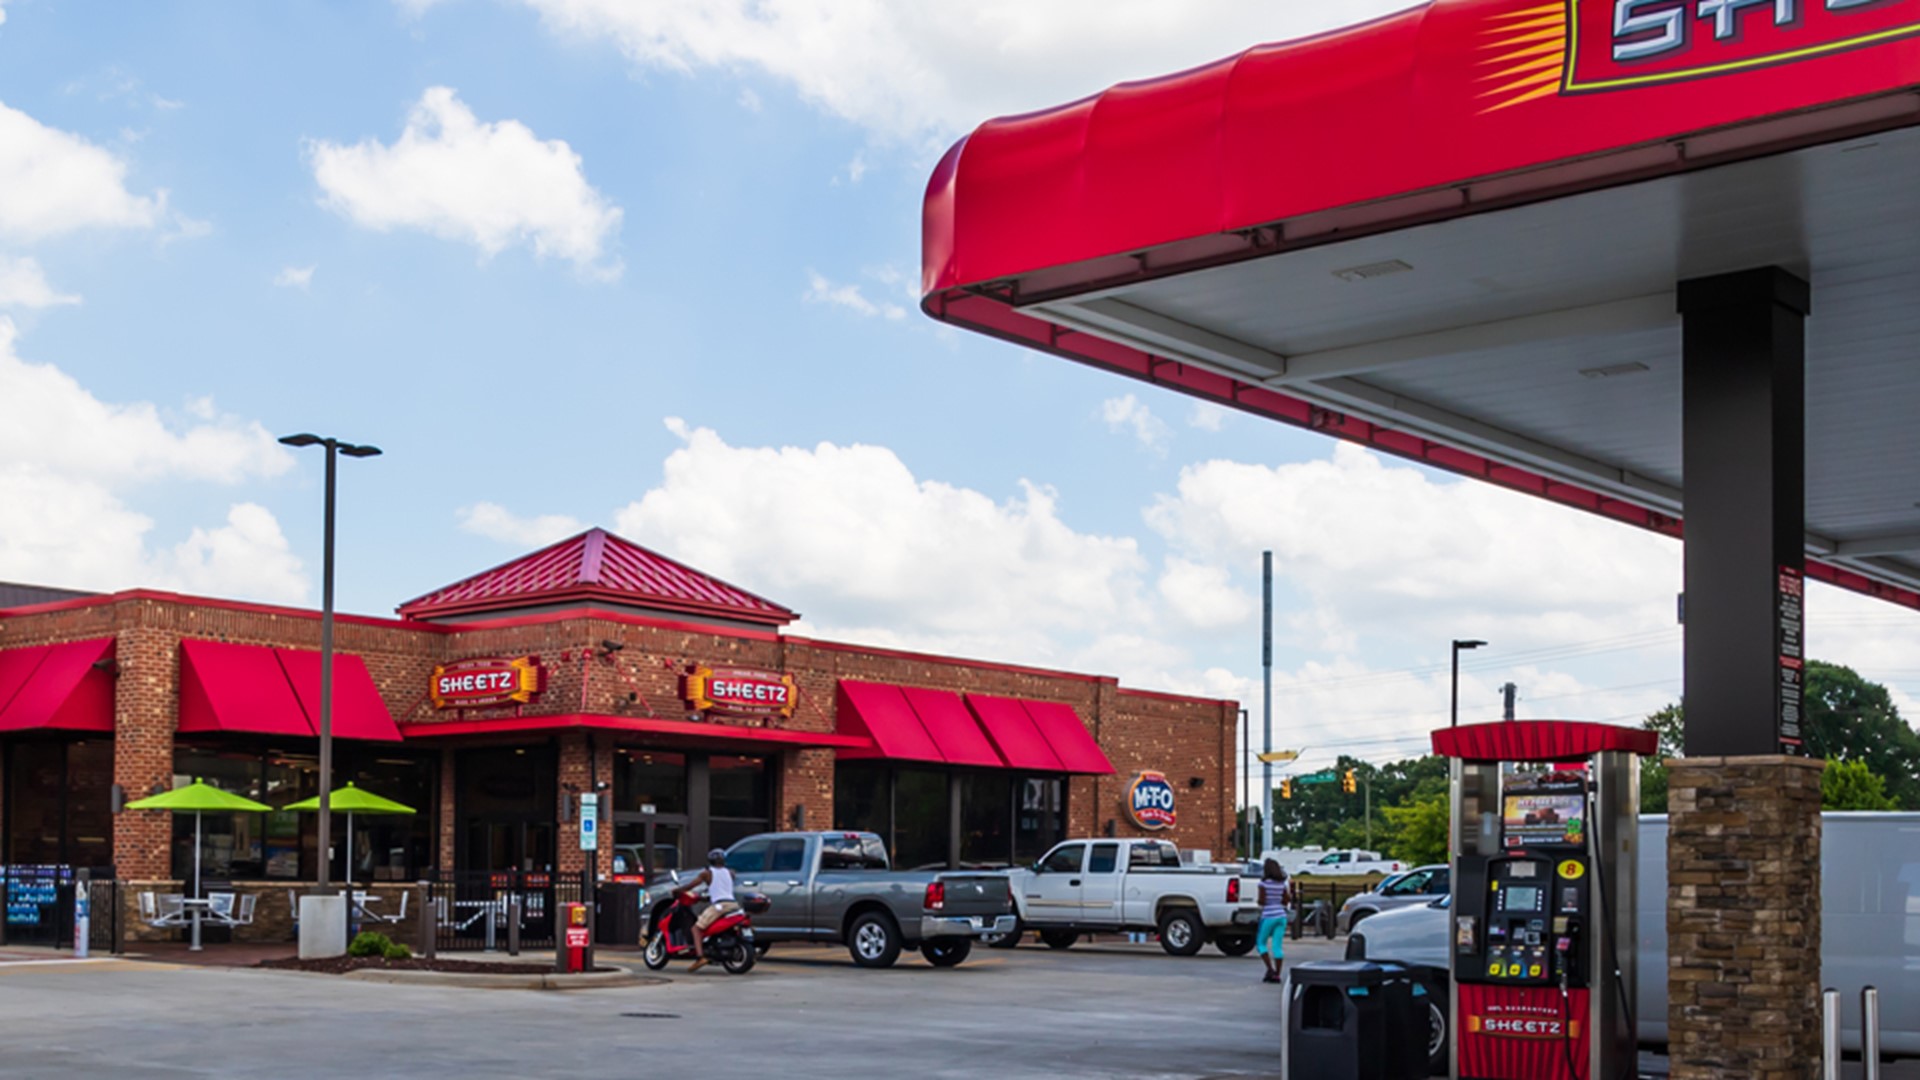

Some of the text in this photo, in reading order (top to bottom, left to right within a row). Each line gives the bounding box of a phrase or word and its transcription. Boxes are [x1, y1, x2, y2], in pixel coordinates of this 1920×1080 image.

[1612, 0, 1879, 61] SH
[439, 671, 512, 694] SHEETZ
[713, 680, 787, 702] SHEETZ
[1565, 863, 1577, 876] 8
[1485, 1018, 1561, 1034] SHEETZ
